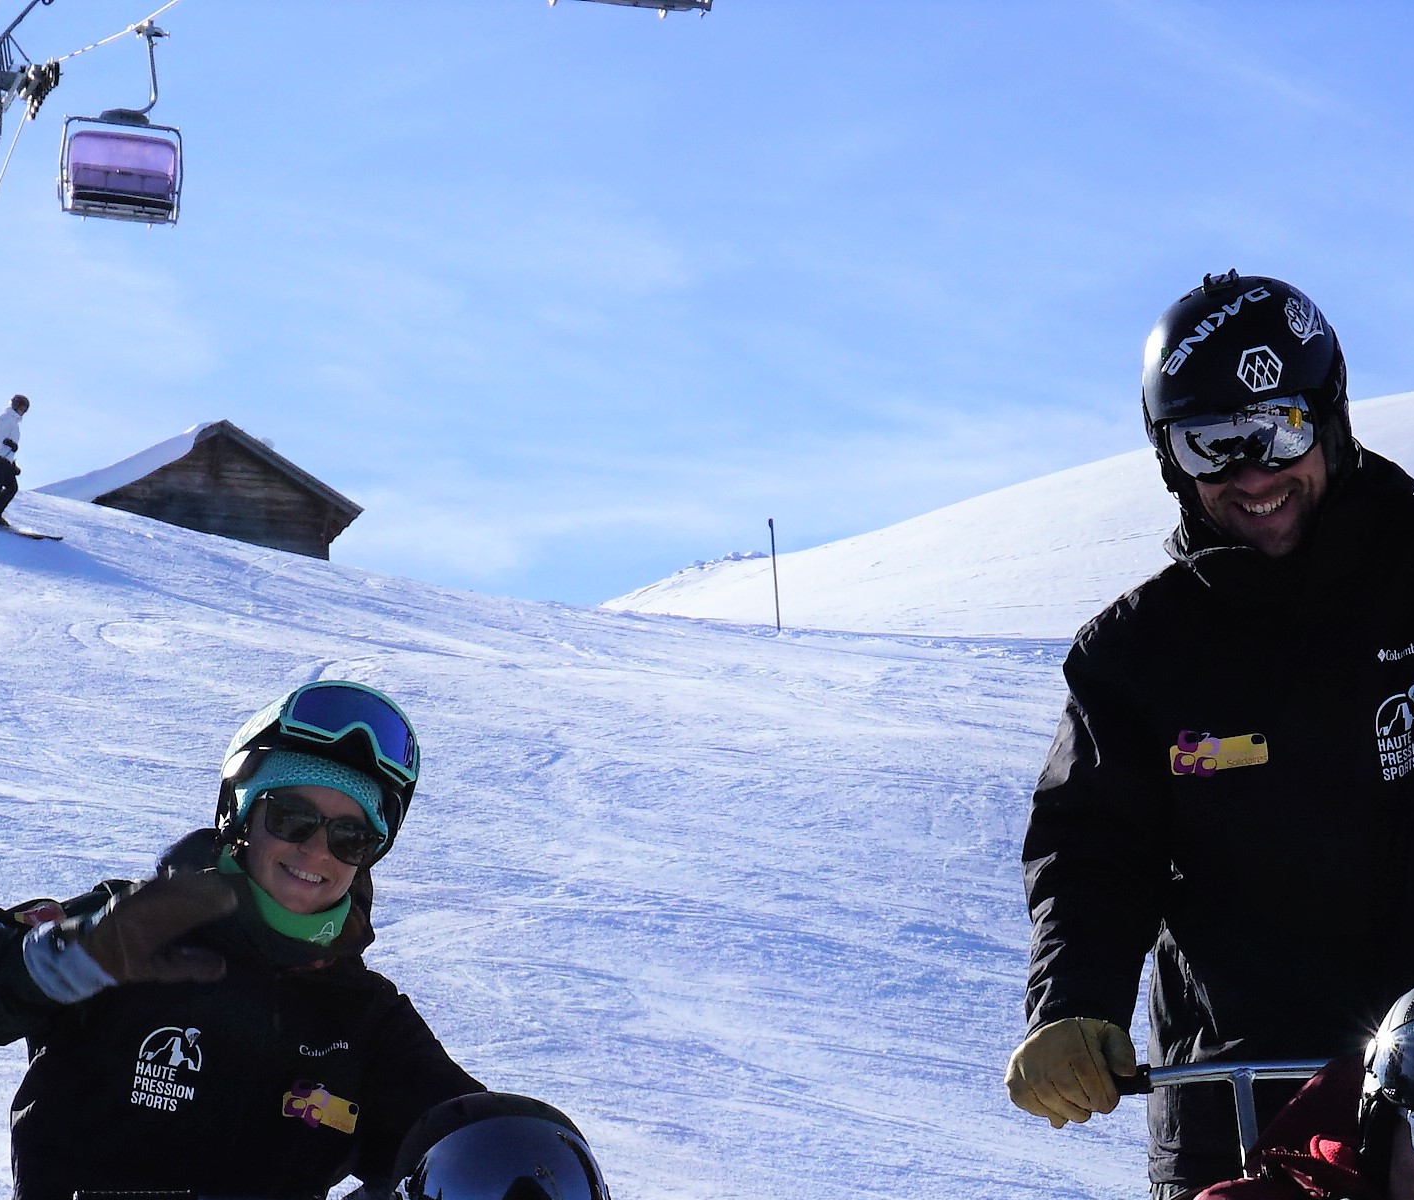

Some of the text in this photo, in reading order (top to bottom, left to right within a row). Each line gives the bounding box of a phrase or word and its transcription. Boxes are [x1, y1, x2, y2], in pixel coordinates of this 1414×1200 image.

[1161, 286, 1270, 377] DAKINE
[1377, 730, 1412, 752] HAUTE
[135, 1060, 178, 1082] HAUTE
[133, 1075, 195, 1101] PRESSION
[130, 1090, 178, 1112] SPORTS
